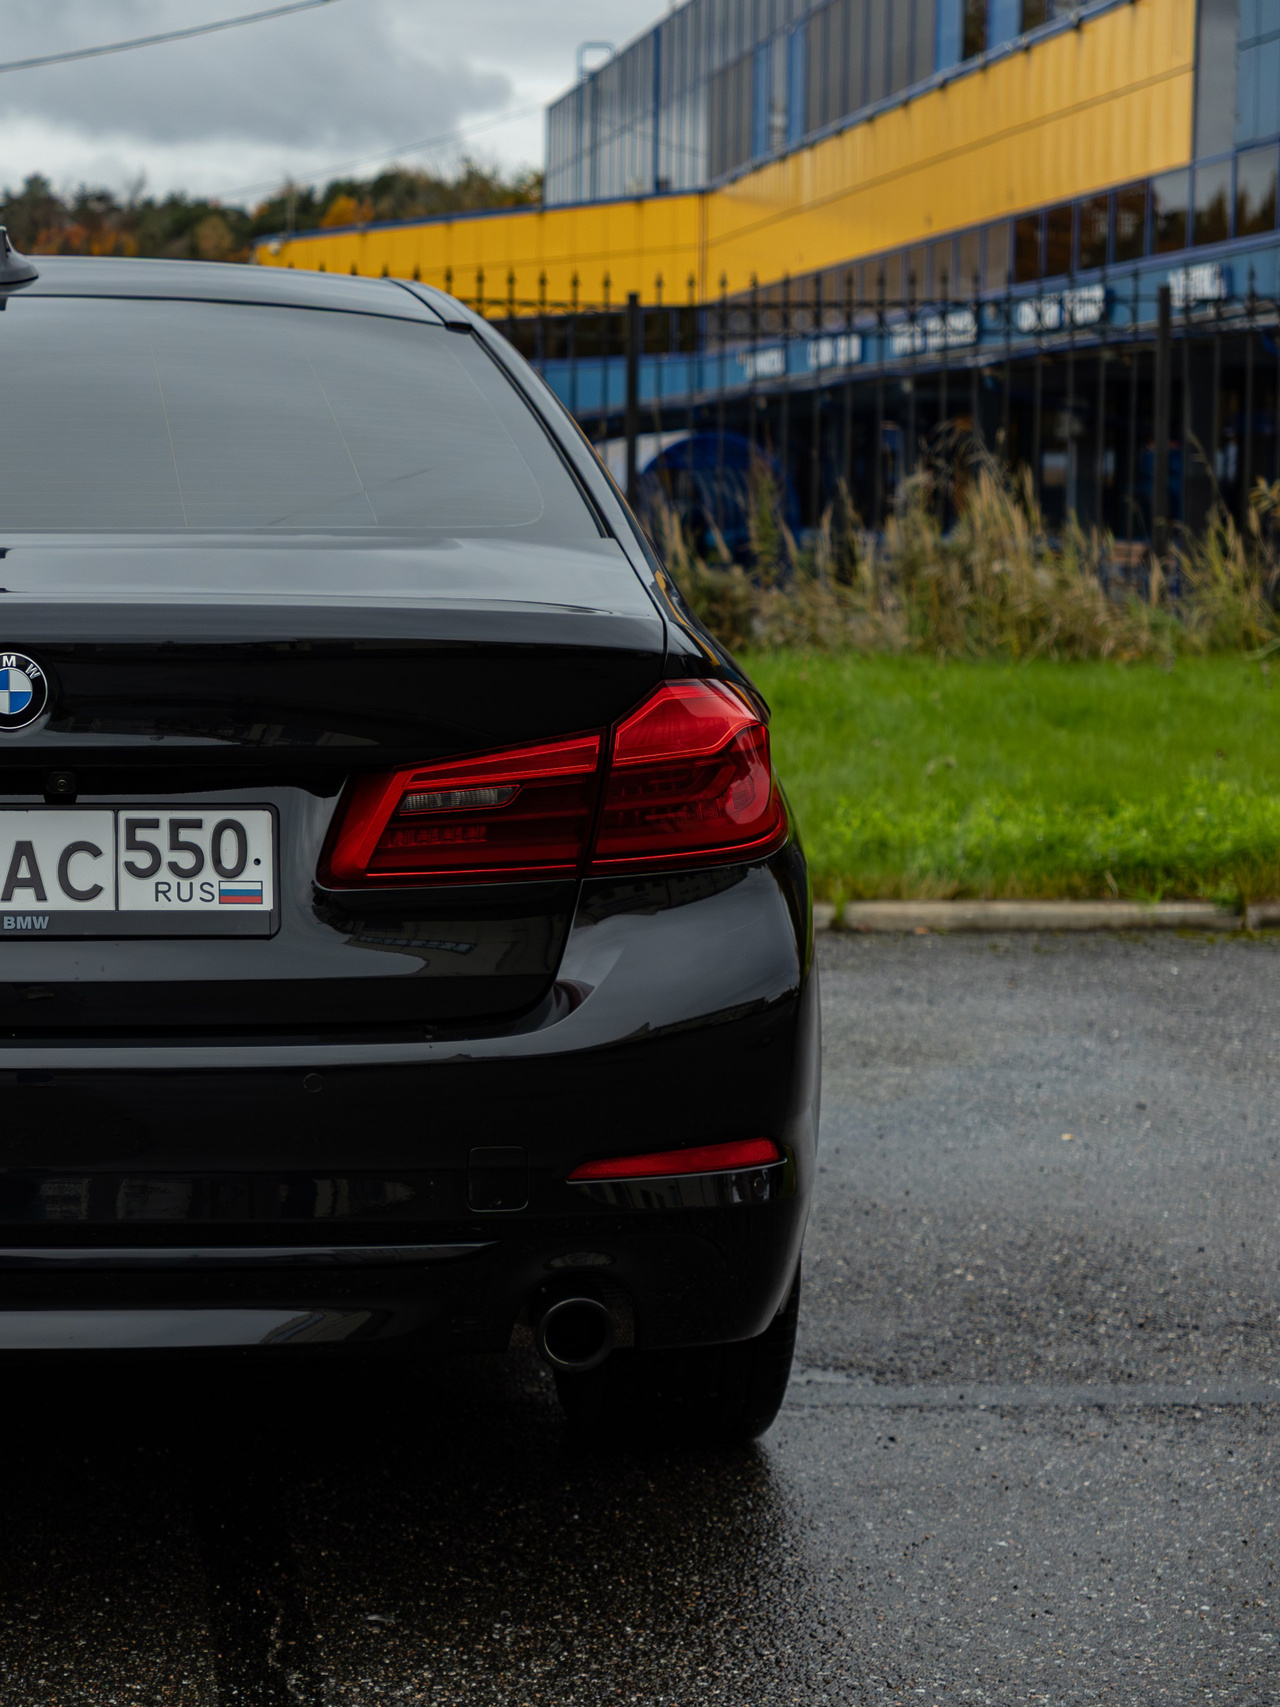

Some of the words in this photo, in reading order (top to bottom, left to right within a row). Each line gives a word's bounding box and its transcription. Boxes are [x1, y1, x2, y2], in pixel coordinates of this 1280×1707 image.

[124, 818, 248, 879] 550
[154, 881, 216, 903] RUS
[3, 916, 49, 929] BMW
